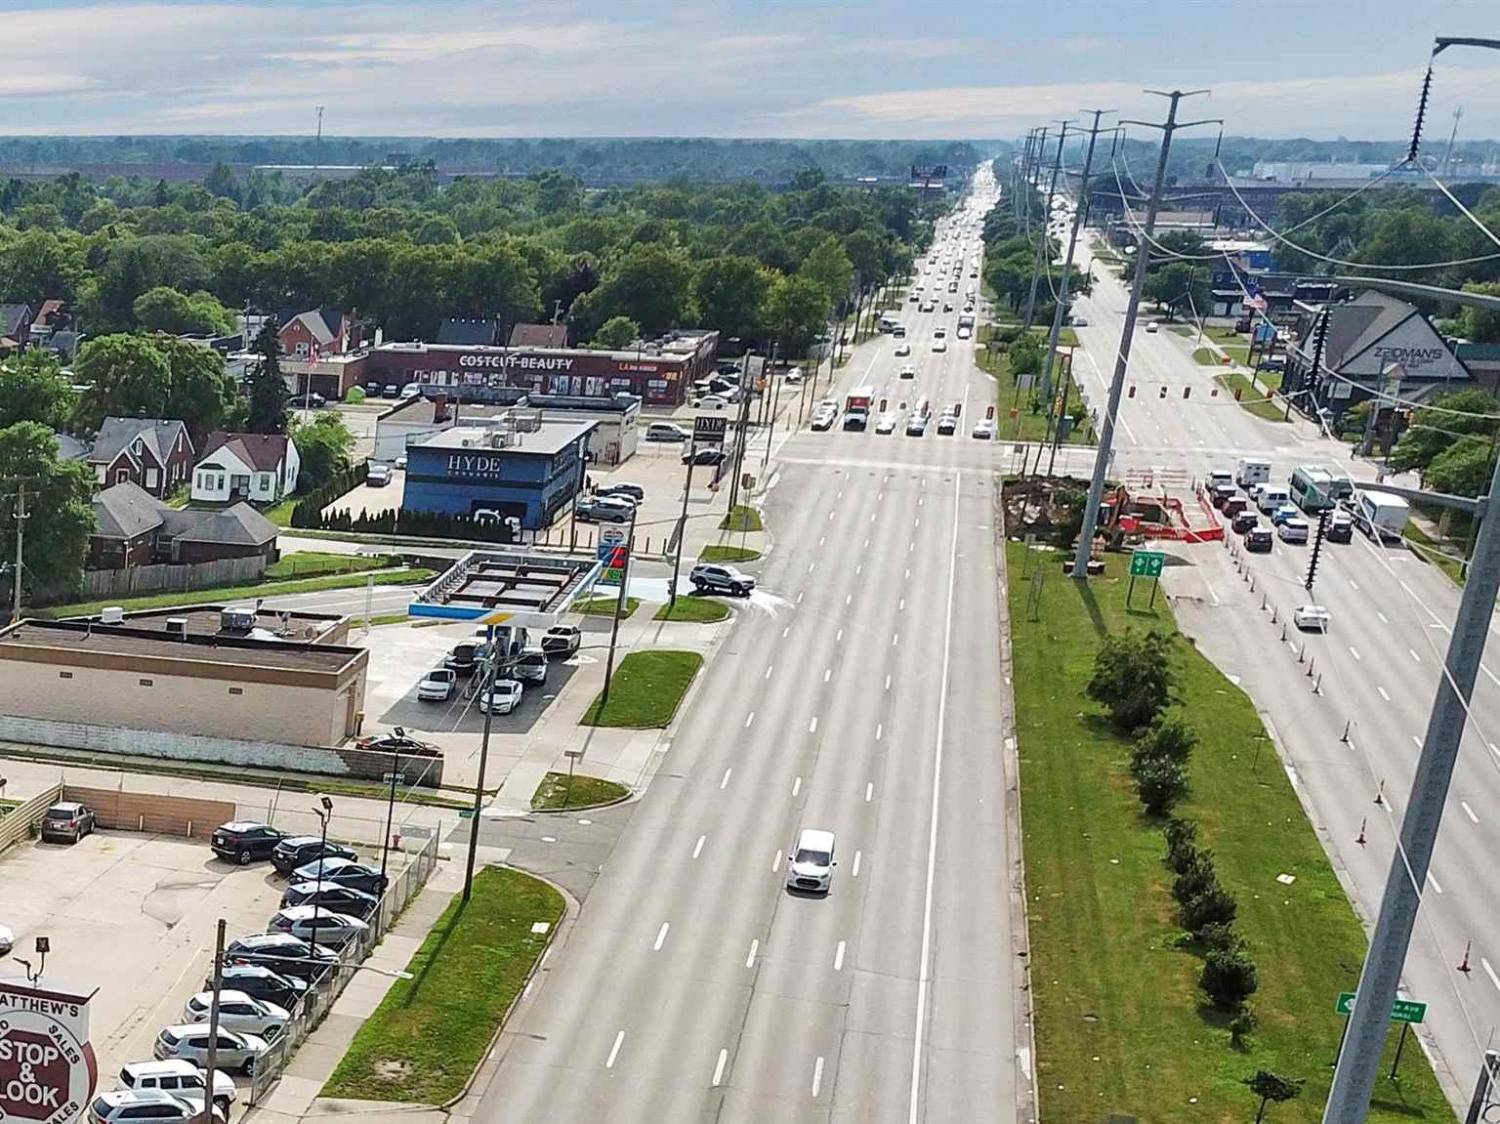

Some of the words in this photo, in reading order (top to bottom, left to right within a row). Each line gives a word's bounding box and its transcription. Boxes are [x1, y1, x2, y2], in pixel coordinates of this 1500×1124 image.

[448, 455, 501, 472] HYDE
[48, 1025, 80, 1064] SALES
[19, 1061, 36, 1083] &
